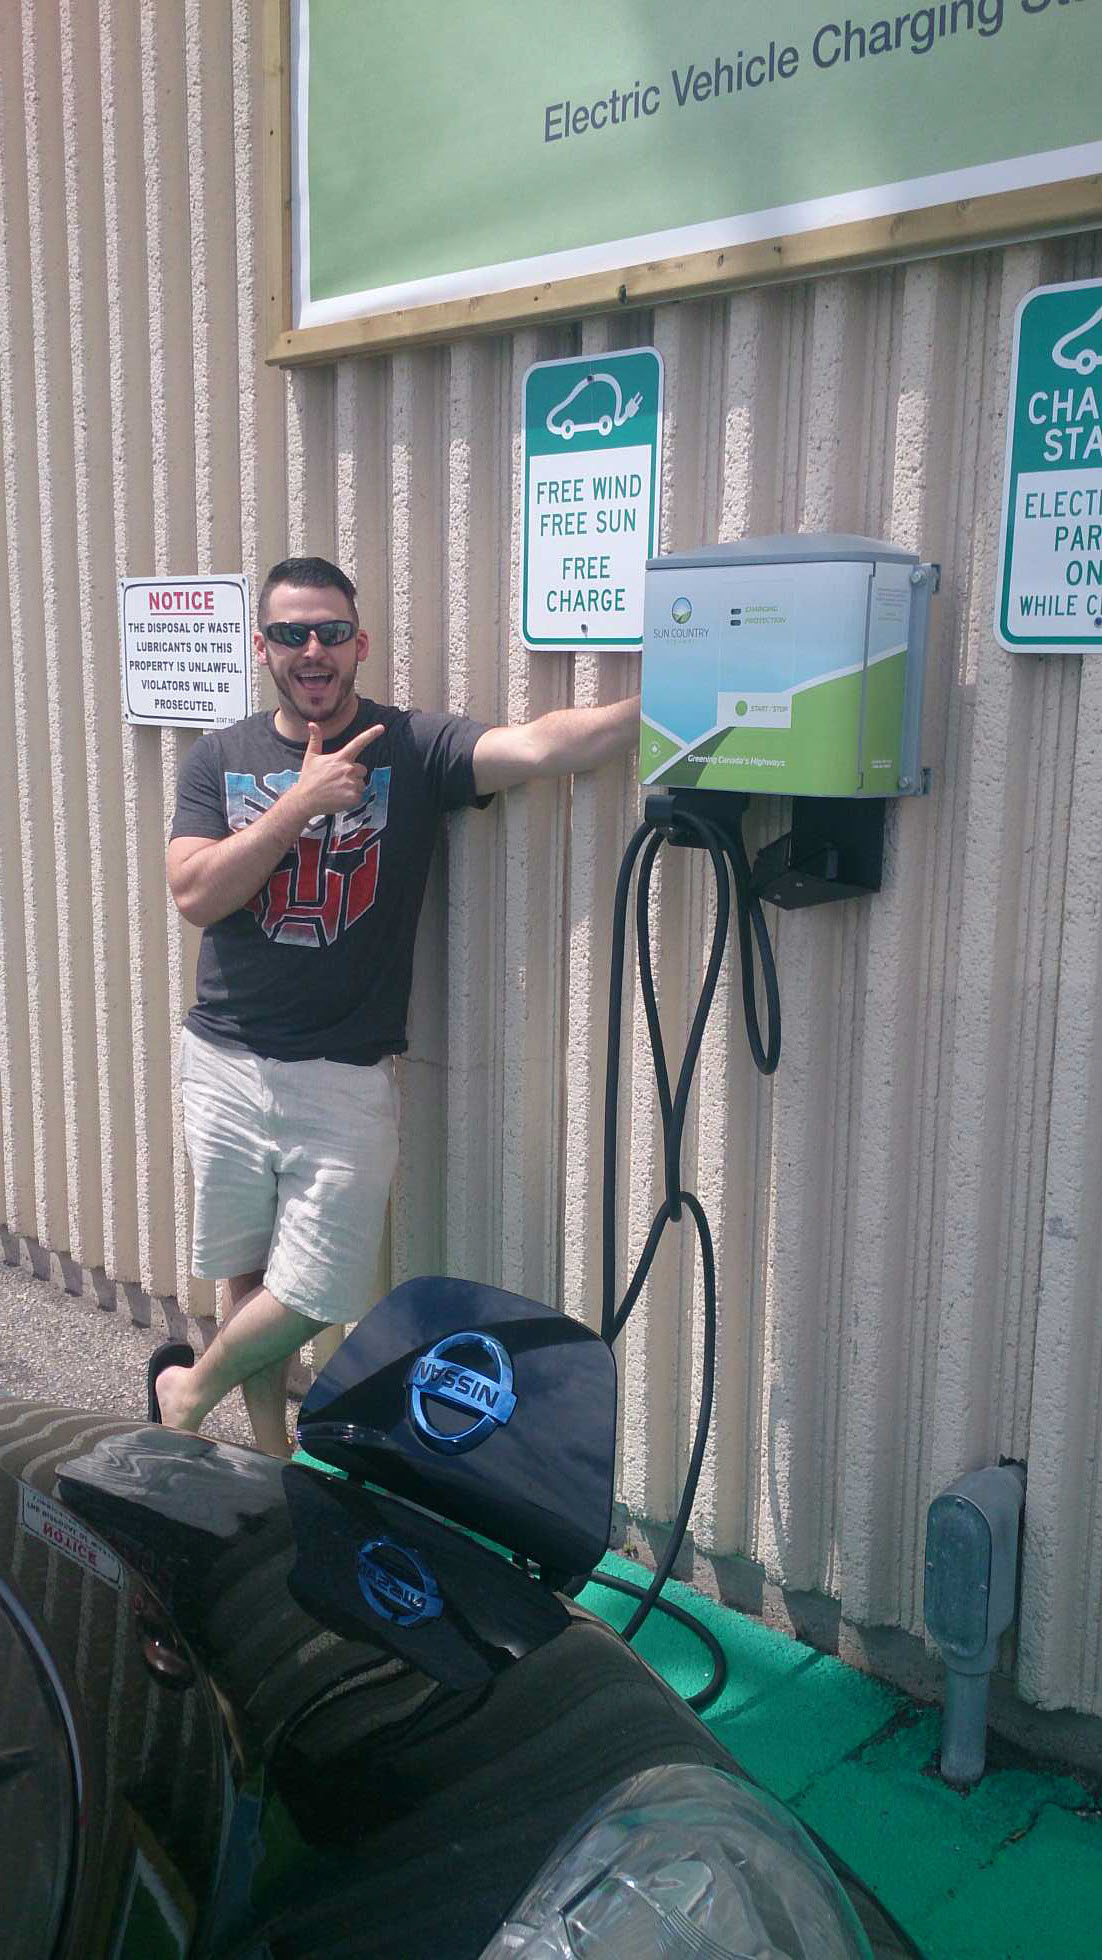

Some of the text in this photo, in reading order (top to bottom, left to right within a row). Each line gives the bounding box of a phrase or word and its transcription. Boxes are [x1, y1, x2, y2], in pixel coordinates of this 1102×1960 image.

[544, 0, 1003, 143] Electric Vehicle Charging
[1028, 386, 1099, 425] CHA
[537, 474, 642, 505] FREE WIND
[1024, 489, 1102, 519] ELECT
[540, 508, 637, 537] FREE SUN
[562, 556, 611, 580] FREE
[148, 591, 215, 611] NOTICE
[546, 588, 626, 613] CHARGE
[1019, 594, 1102, 617] WHILE C
[128, 622, 241, 633] THE DISPOSAL OF WASTE
[653, 628, 710, 639] SUN COUNTRY
[136, 641, 232, 653] LUBRICANTS ON THIS
[129, 660, 243, 674] PROPERTY IS UNLAWFUL.
[141, 679, 230, 693] VIOLATORS WILL BE
[154, 698, 217, 712] PROSECUTED.
[687, 754, 786, 768] Greening Canada's Highways
[419, 1360, 500, 1409] NISSAN
